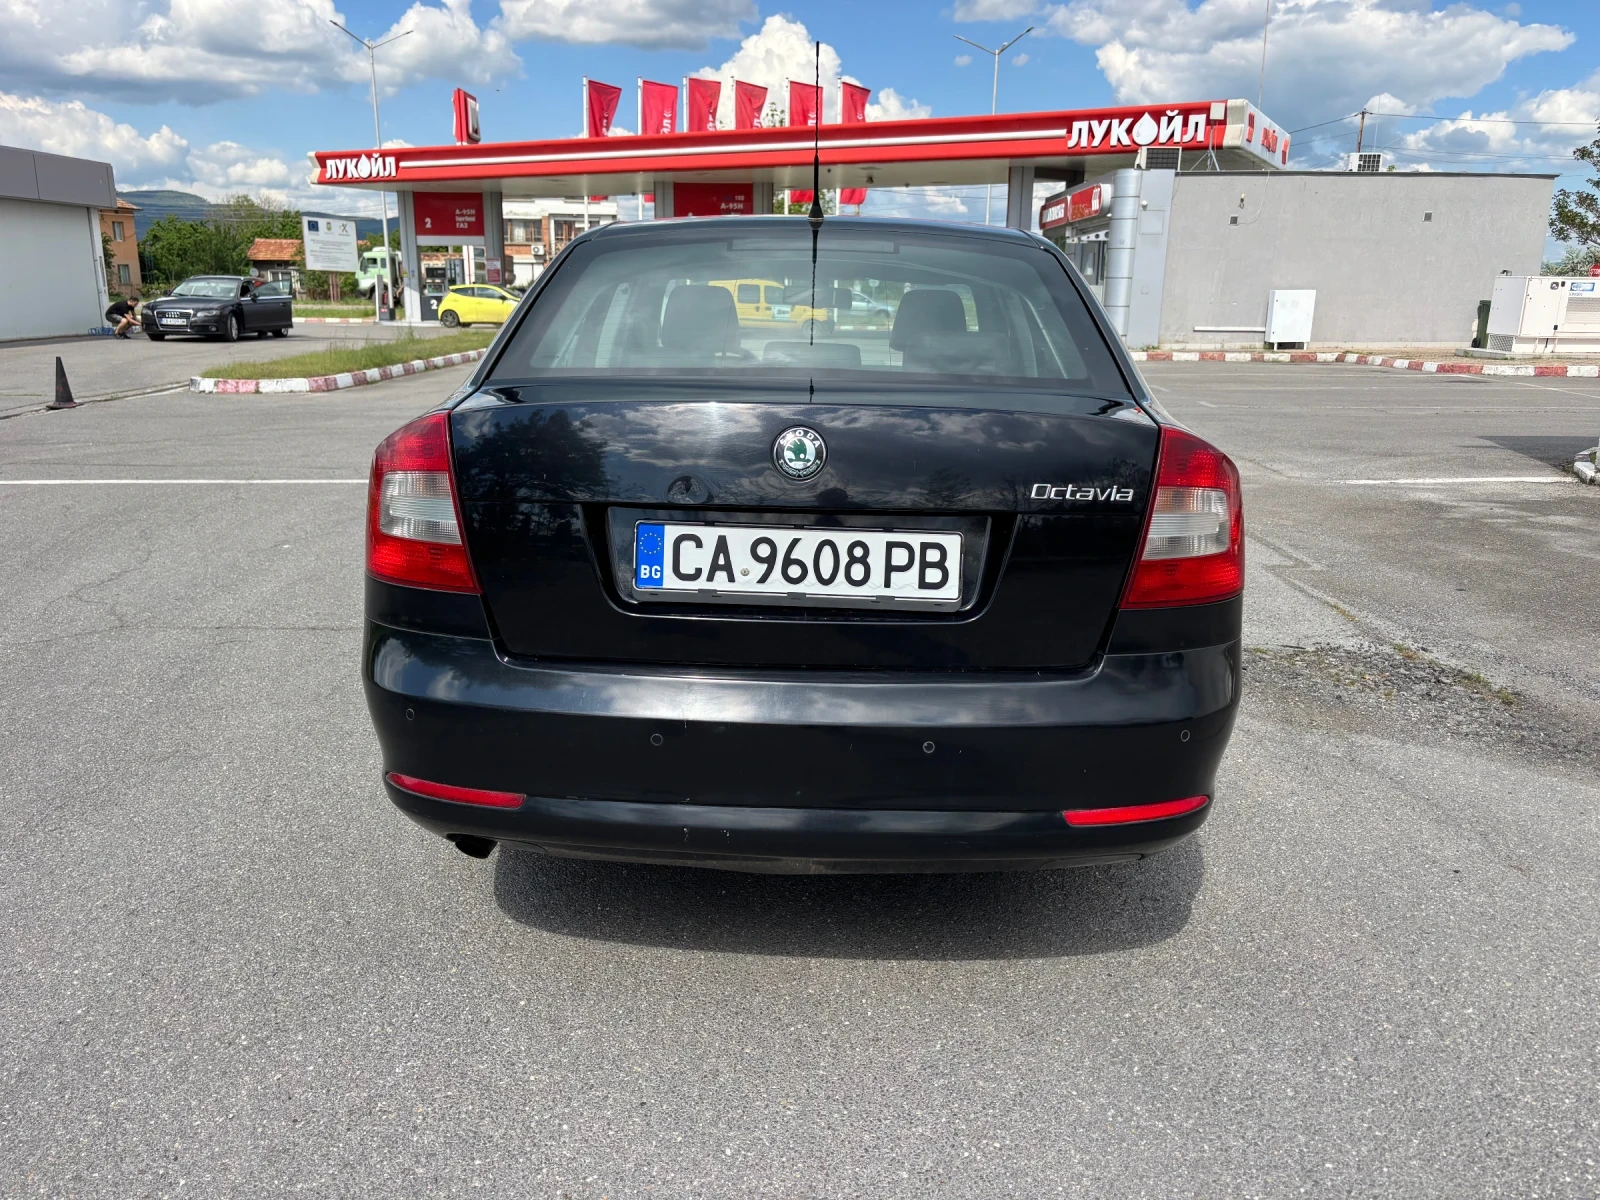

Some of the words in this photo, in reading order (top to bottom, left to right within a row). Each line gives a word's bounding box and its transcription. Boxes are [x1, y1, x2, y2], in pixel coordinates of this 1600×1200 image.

[1067, 109, 1208, 148] ЛУКОЙЛ
[325, 153, 397, 180] ЛУКОЙЛ
[424, 217, 432, 229] 2
[430, 299, 438, 310] 2
[1030, 483, 1134, 501] Octavia
[749, 536, 872, 588] 9608
[640, 564, 661, 579] BG
